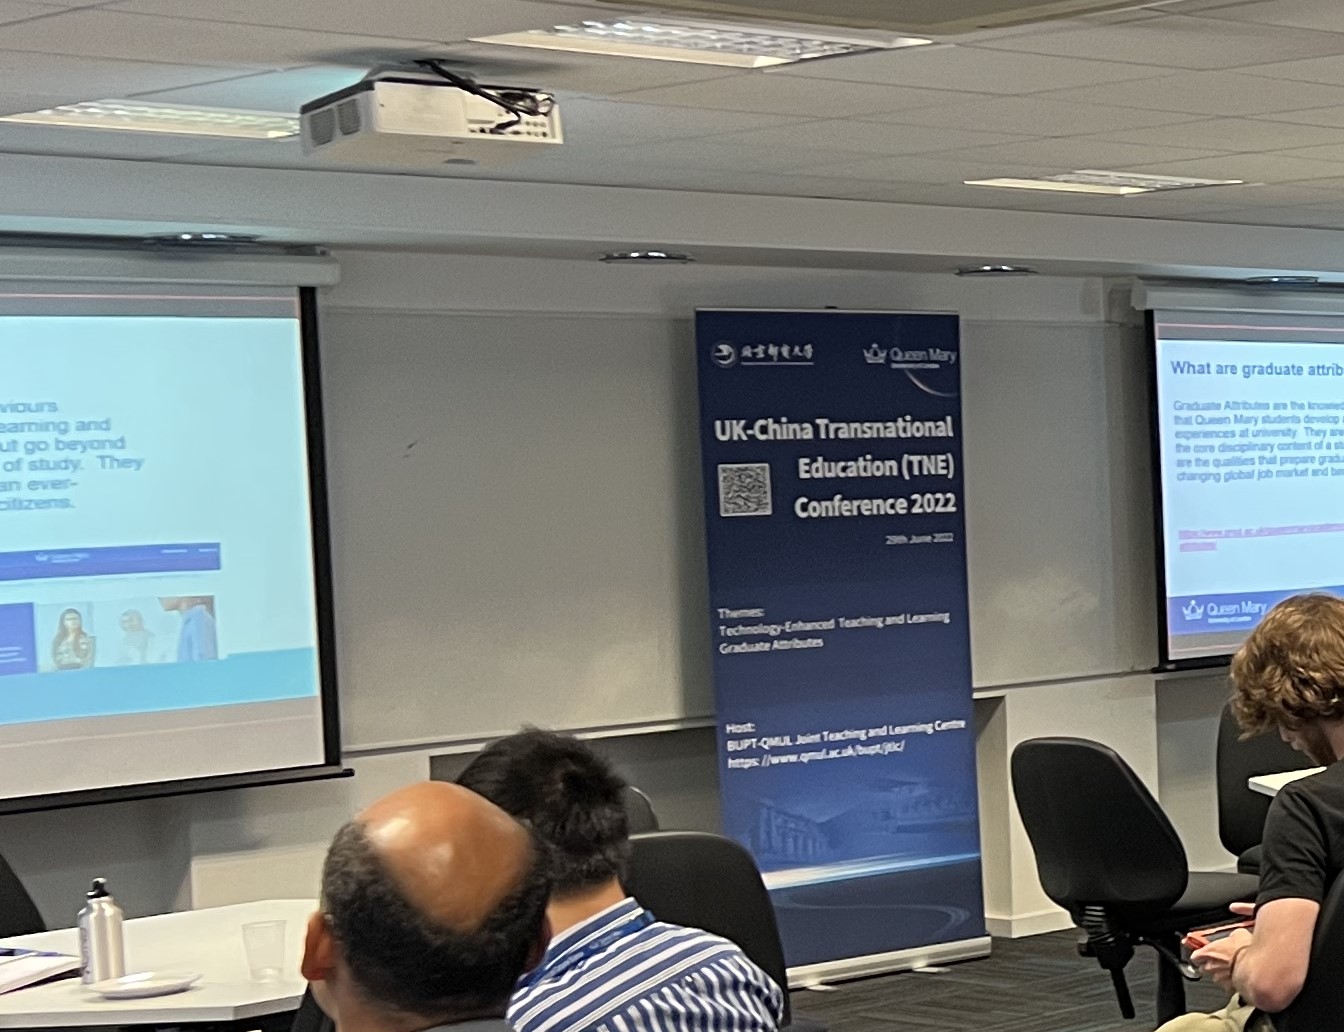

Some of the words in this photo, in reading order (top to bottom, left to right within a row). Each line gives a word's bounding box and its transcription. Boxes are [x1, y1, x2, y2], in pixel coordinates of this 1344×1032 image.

[890, 347, 928, 362] Queen
[929, 348, 958, 364] Mary
[1171, 361, 1211, 375] What
[1216, 364, 1237, 375] are
[1242, 363, 1303, 378] graduate
[1174, 400, 1221, 411] Graduate
[1224, 401, 1270, 411] Attributes
[1273, 402, 1287, 410] are
[1290, 401, 1305, 410] the
[75, 417, 111, 431] and
[714, 416, 813, 441] UK-China
[815, 415, 954, 440] Transnational
[1195, 415, 1231, 425] Queen
[1234, 414, 1258, 426] Mary
[1304, 427, 1327, 438] They
[1330, 429, 1344, 437] are
[24, 440, 48, 455] go
[55, 436, 126, 453] beyond
[1314, 440, 1323, 450] of
[3, 458, 22, 472] of
[28, 458, 85, 473] study.
[96, 455, 145, 471] They
[798, 455, 898, 479] Education
[902, 453, 954, 480] (TNE)
[27, 479, 78, 490] ever-
[794, 495, 908, 518] Conference
[911, 493, 957, 513] 2022
[717, 608, 765, 619] Themes:
[1207, 602, 1240, 616] Queen
[1241, 601, 1267, 615] Mary
[719, 618, 835, 636] Technology-Enhanced
[838, 616, 884, 628] Teaching
[885, 613, 905, 625] and
[907, 611, 950, 624] Learning
[719, 641, 770, 654] Graduate
[772, 638, 824, 650] Attributes
[726, 723, 755, 734] Host:
[727, 736, 792, 752] BUPT-QMUL
[795, 733, 821, 746] Joint
[822, 729, 867, 742] Teaching
[868, 725, 887, 737] and
[888, 722, 934, 735] Learning
[934, 719, 966, 731] Centre
